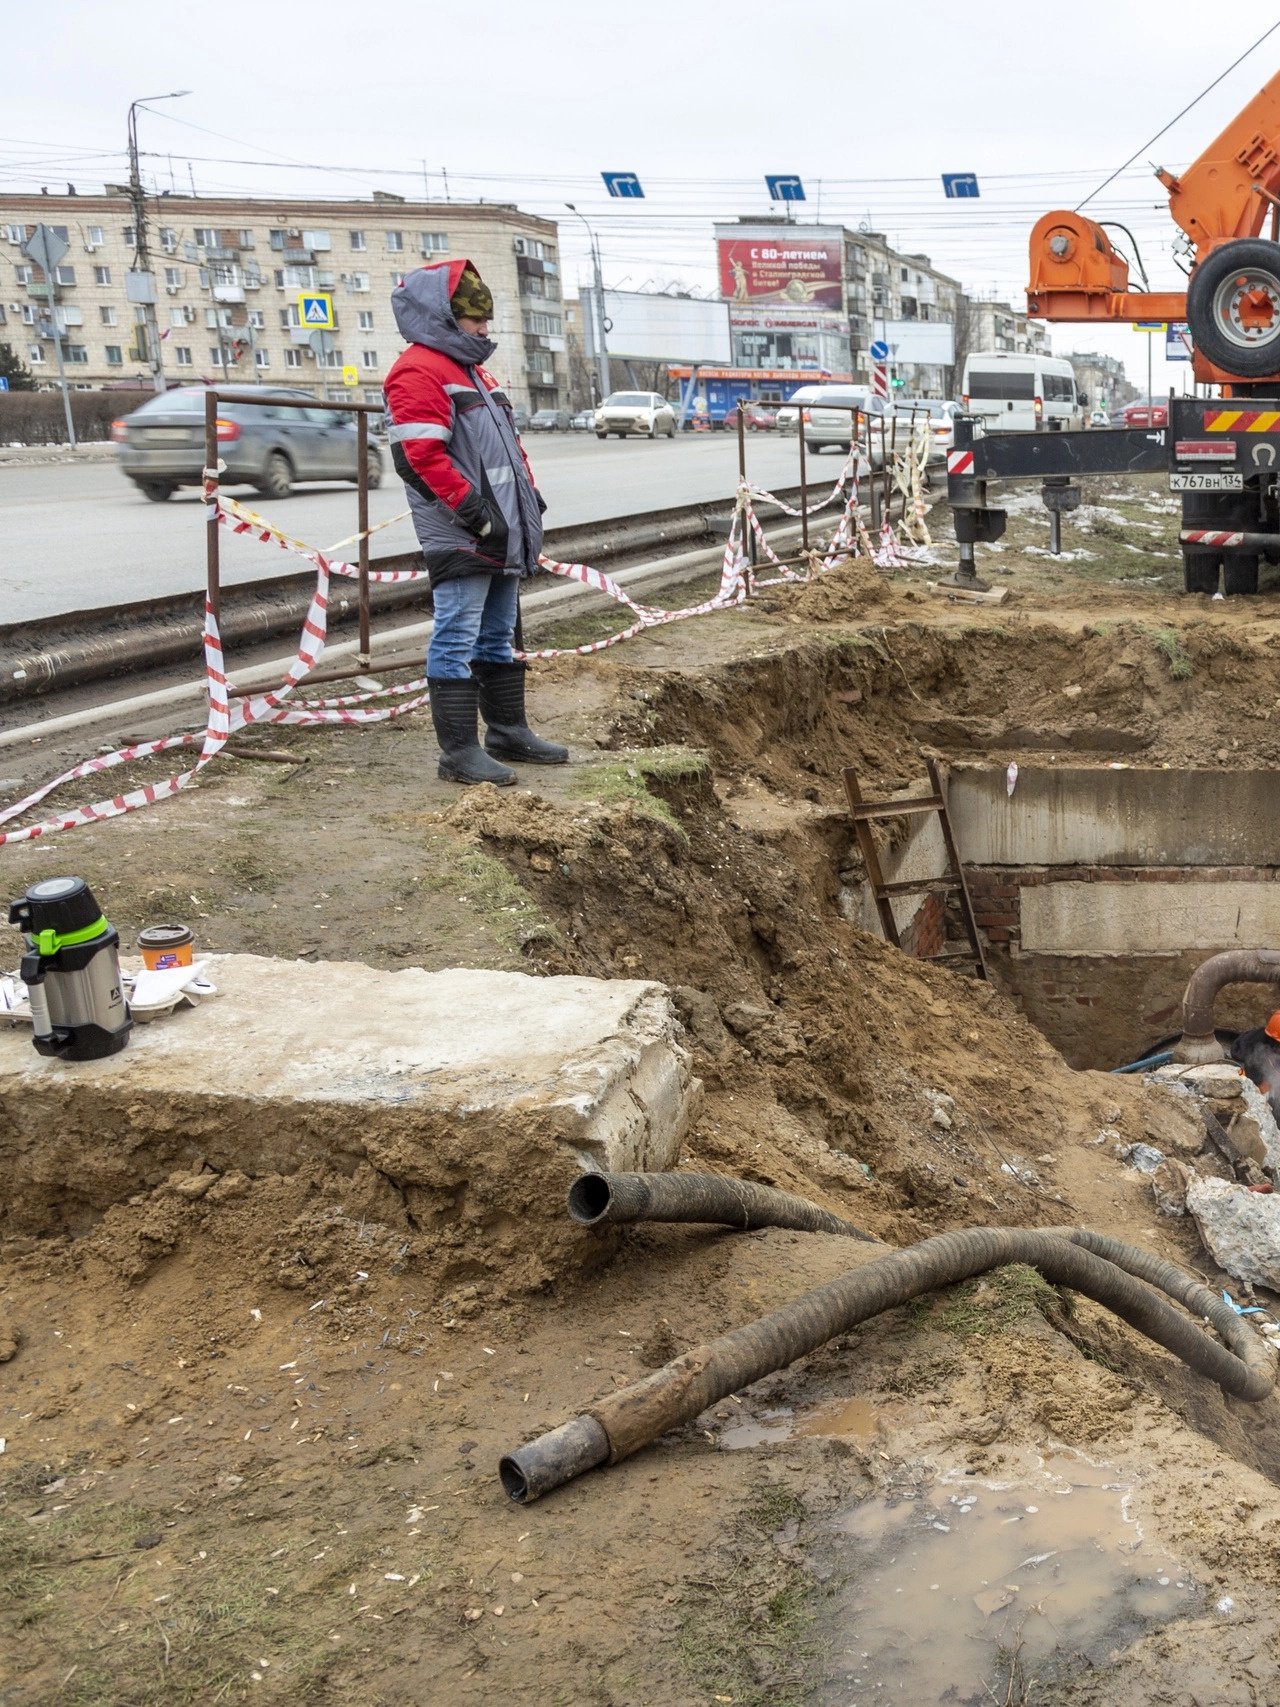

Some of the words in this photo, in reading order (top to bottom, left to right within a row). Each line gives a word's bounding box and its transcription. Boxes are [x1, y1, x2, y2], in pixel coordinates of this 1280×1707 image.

[750, 248, 758, 259] С
[761, 248, 828, 260] 80-летием
[751, 261, 787, 270] Великой
[788, 261, 821, 270] победы
[760, 270, 826, 280] Сталинградской
[1222, 474, 1241, 485] 134
